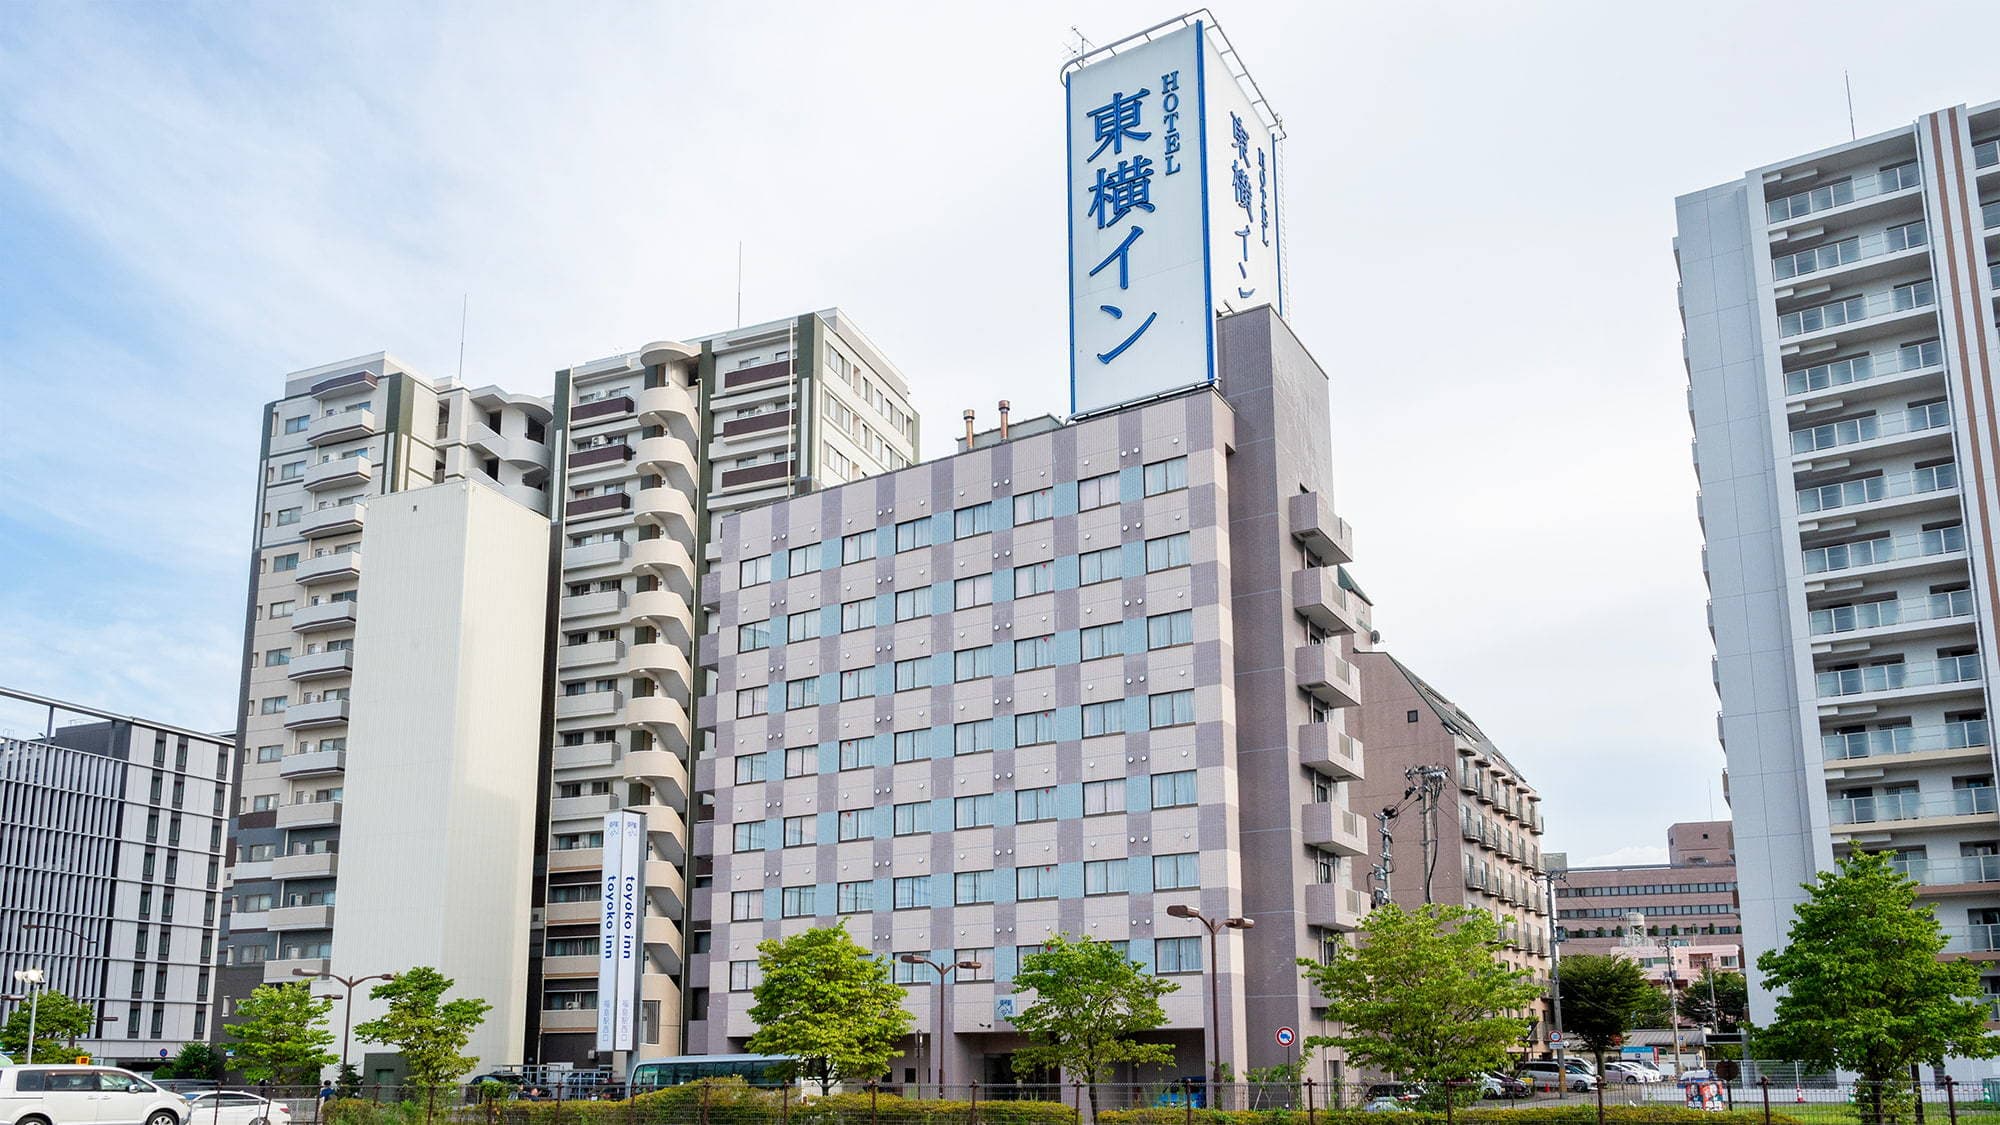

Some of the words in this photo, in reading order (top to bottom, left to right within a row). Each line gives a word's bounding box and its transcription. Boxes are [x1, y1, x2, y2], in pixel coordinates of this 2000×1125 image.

[1161, 69, 1181, 176] HOTEL
[1087, 87, 1157, 365] 東横イン
[605, 875, 616, 930] toyoko
[623, 876, 635, 930] toyoko
[605, 935, 615, 959] inn
[623, 935, 634, 959] inn
